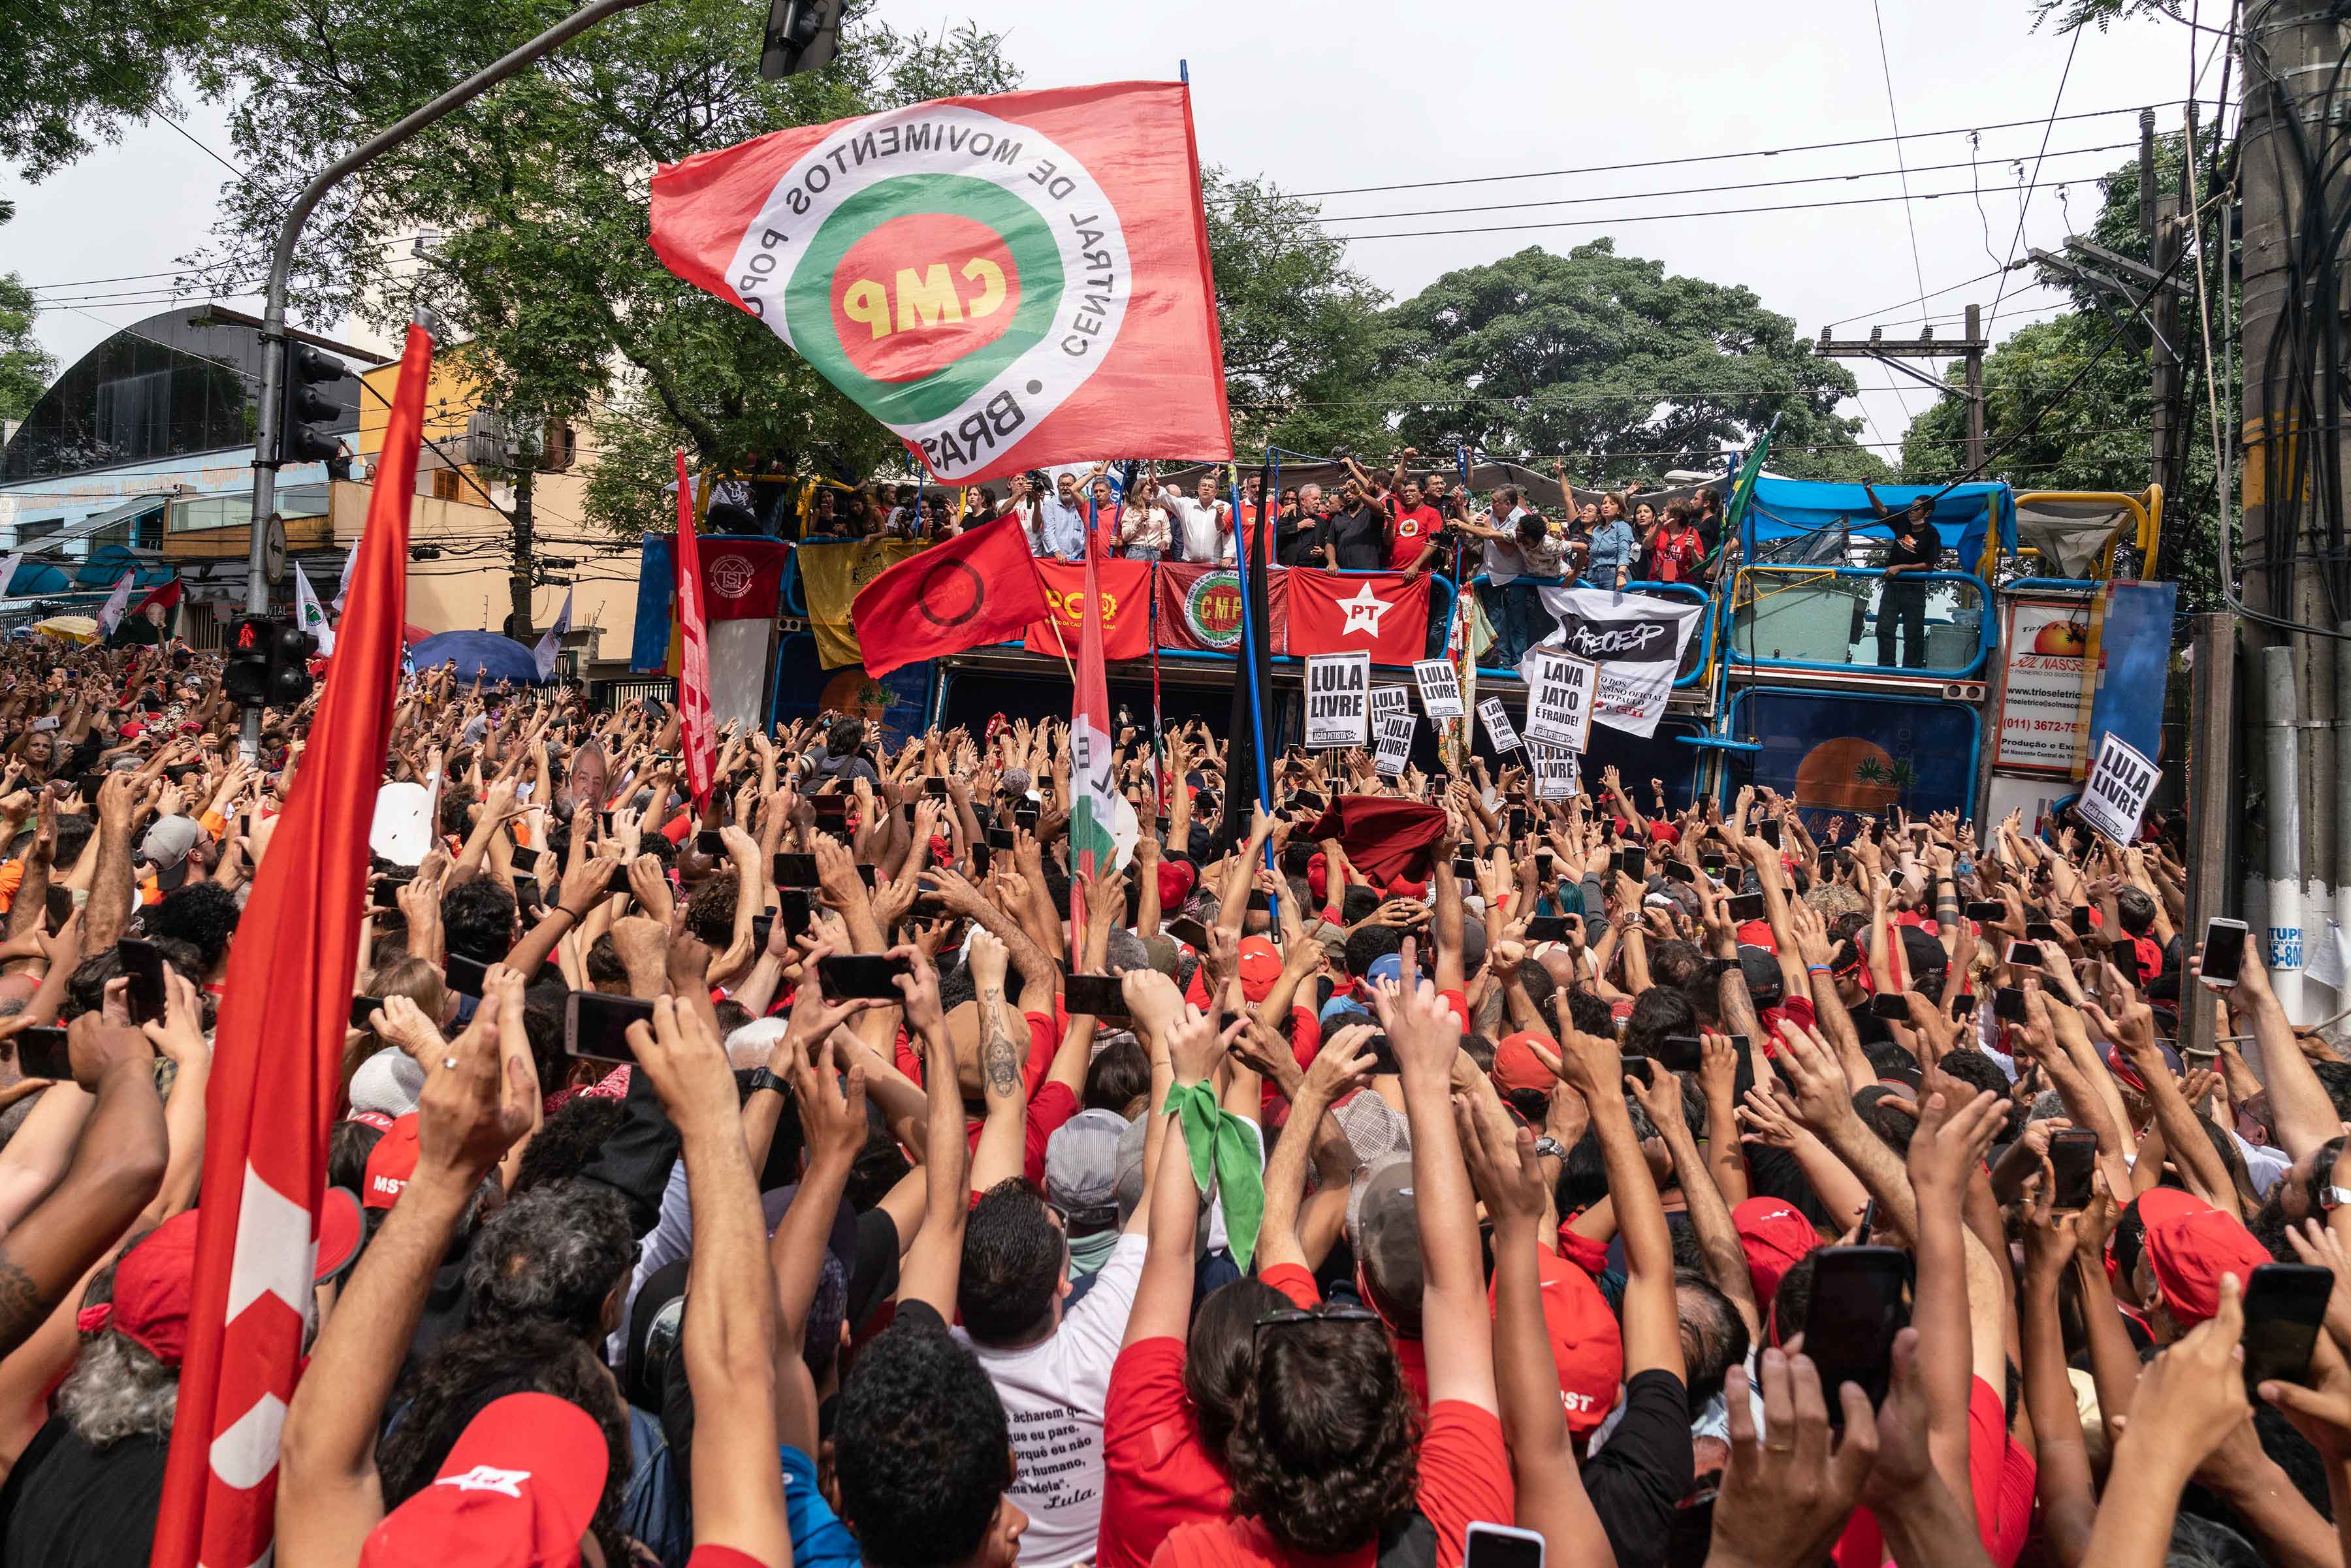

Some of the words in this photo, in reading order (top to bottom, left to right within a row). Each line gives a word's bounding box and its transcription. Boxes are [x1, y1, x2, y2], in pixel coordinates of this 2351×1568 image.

[1185, 588, 1196, 618] CENTRAL
[1206, 569, 1241, 580] MOVIMEN
[1200, 595, 1243, 620] CMP
[1351, 605, 1379, 622] PT
[1215, 638, 1235, 647] PAULO
[2010, 656, 2039, 668] SOL
[2039, 658, 2085, 672] NASCE
[1311, 664, 1364, 692] LULA
[1418, 665, 1454, 684] LULA
[1543, 661, 1584, 688] LAVA
[1610, 678, 1627, 687] DOS
[1372, 691, 1405, 709] LULA
[1422, 684, 1458, 700] LIVRE
[1540, 685, 1579, 711] JATO
[1597, 691, 1613, 699] SÃO
[1616, 694, 1646, 706] PAULO
[1628, 690, 1663, 702] OFICIAL
[2007, 687, 2082, 699] www.trioseletric
[1311, 694, 1363, 718] LIVRE
[1485, 701, 1503, 716] LAV
[1618, 707, 1644, 717] CUT
[2006, 698, 2080, 709] trioeletrico@solnasce
[1535, 705, 1541, 718] É
[1543, 710, 1579, 727] FRAUDE!
[2003, 718, 2031, 731] (011)
[1313, 732, 1327, 741] AÇÃO
[1327, 731, 1347, 740] PETISTA
[1384, 718, 1412, 740] LULA
[1535, 728, 1548, 737] AÇÃO
[1548, 729, 1566, 743] PETISTA
[1379, 738, 1408, 758] LIVRE
[2002, 739, 2047, 750] Produção
[1537, 762, 1573, 778] LIVRE
[2101, 745, 2151, 799] LULA
[2092, 771, 2139, 821] LIVRE
[1014, 1408, 1064, 1424] acharem
[1031, 1432, 1046, 1442] eu
[1049, 1425, 1080, 1441] pare.
[1051, 1446, 1066, 1455] eu
[1070, 1436, 1091, 1450] não
[1032, 1458, 1087, 1477] humano,
[1044, 1487, 1097, 1511] Lula.
